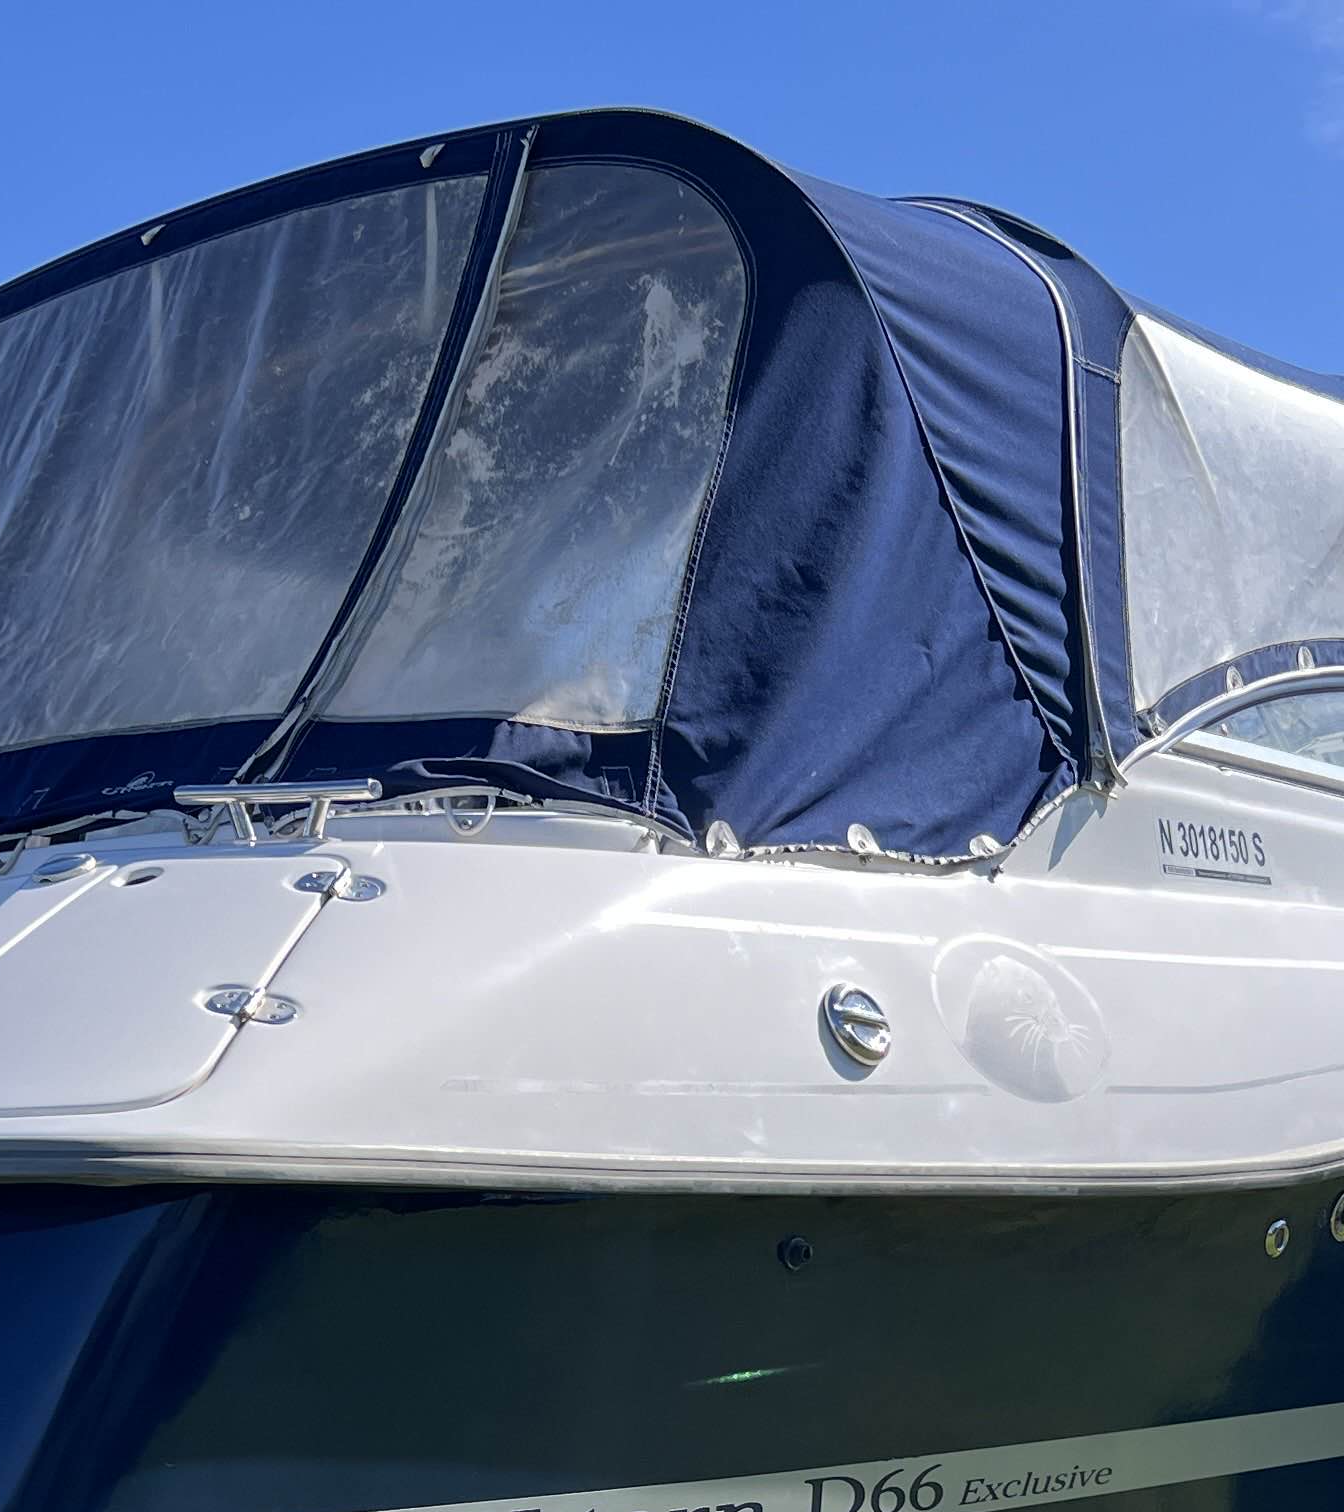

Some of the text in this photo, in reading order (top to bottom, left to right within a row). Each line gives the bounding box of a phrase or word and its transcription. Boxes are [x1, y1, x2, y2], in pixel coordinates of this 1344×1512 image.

[1158, 818, 1266, 867] N 3018150 S
[958, 1465, 1113, 1507] Exclusive
